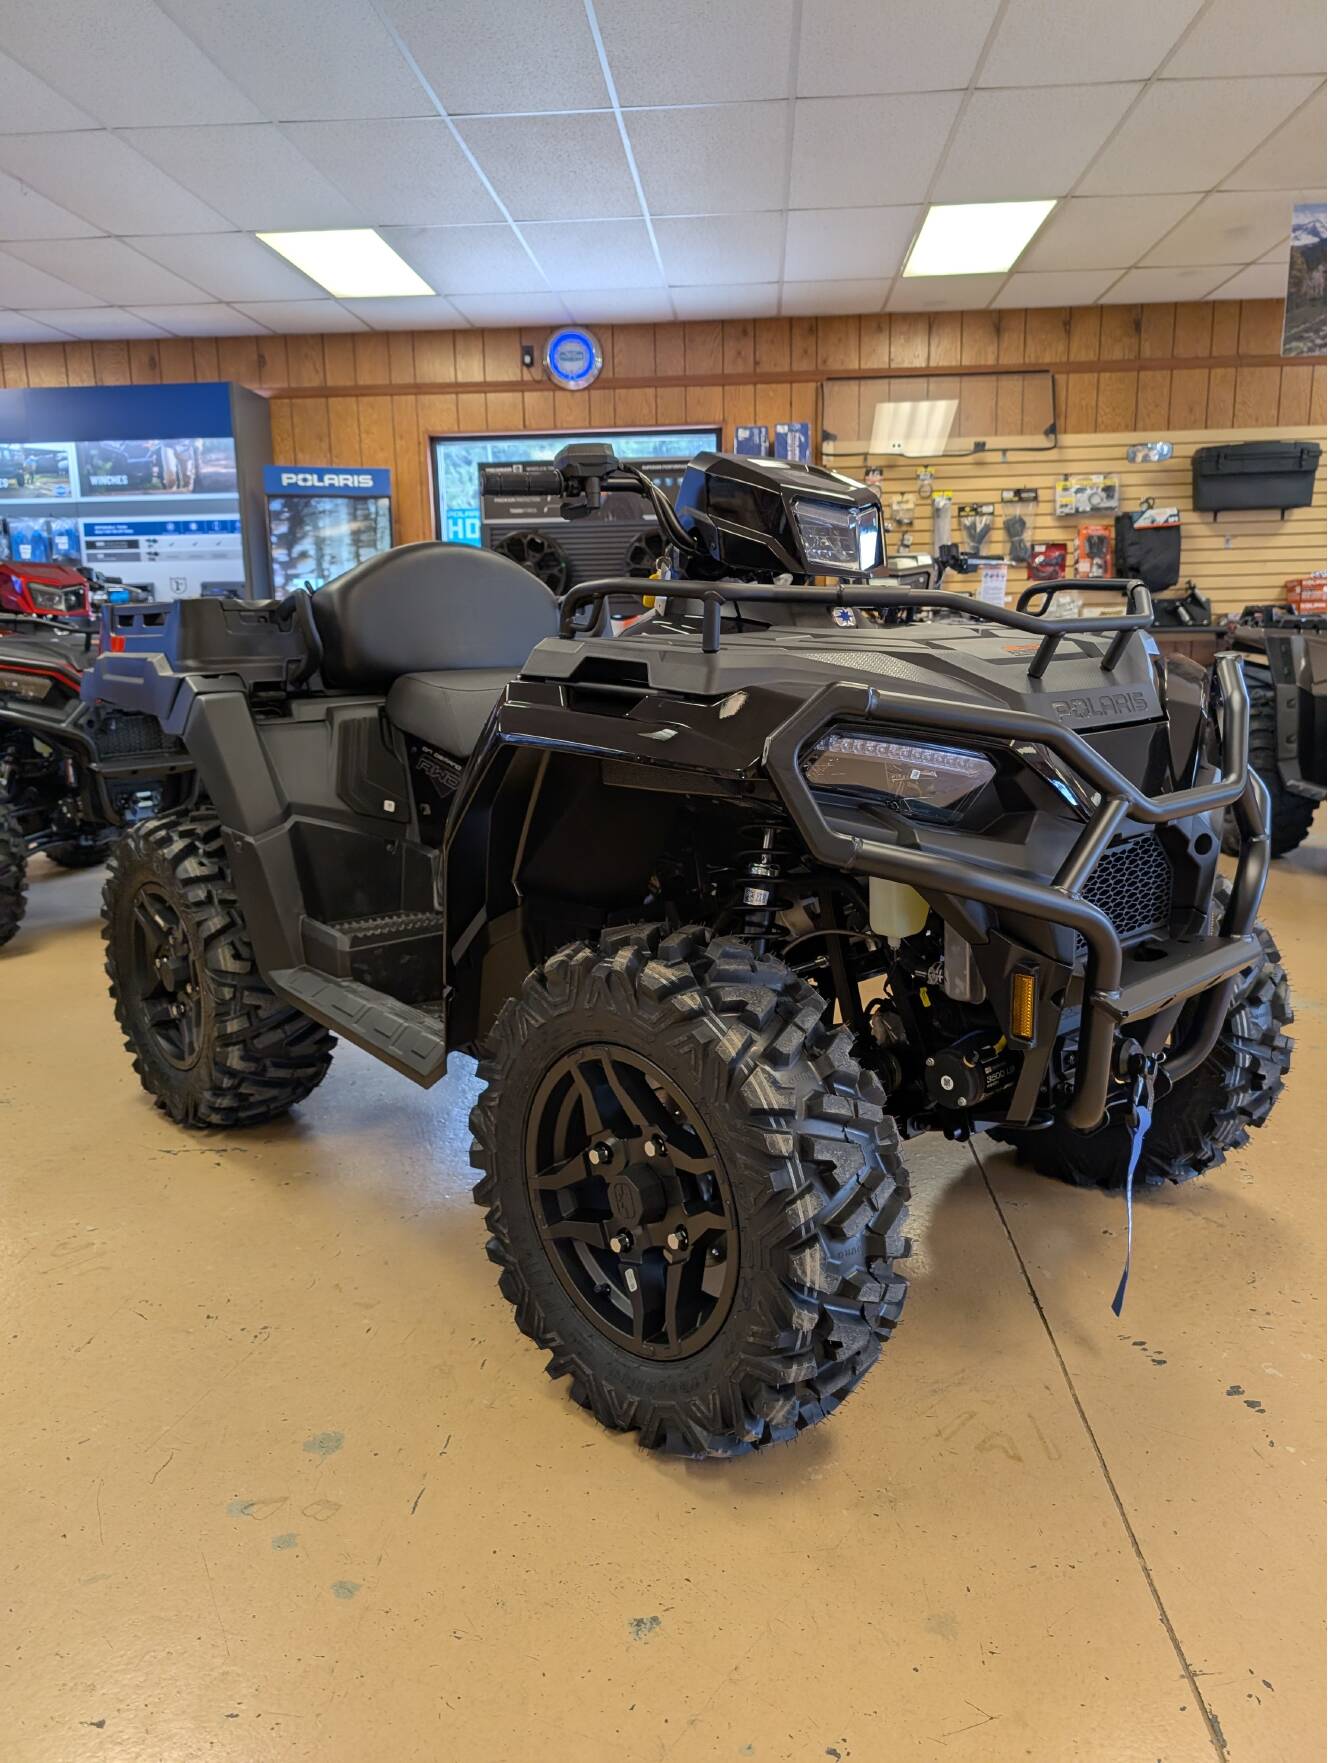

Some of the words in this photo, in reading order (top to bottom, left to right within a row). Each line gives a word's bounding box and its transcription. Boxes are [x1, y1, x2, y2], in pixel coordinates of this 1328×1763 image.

[89, 474, 129, 486] WINCHES
[281, 473, 374, 488] POLARIS
[1051, 691, 1149, 722] POLARIS
